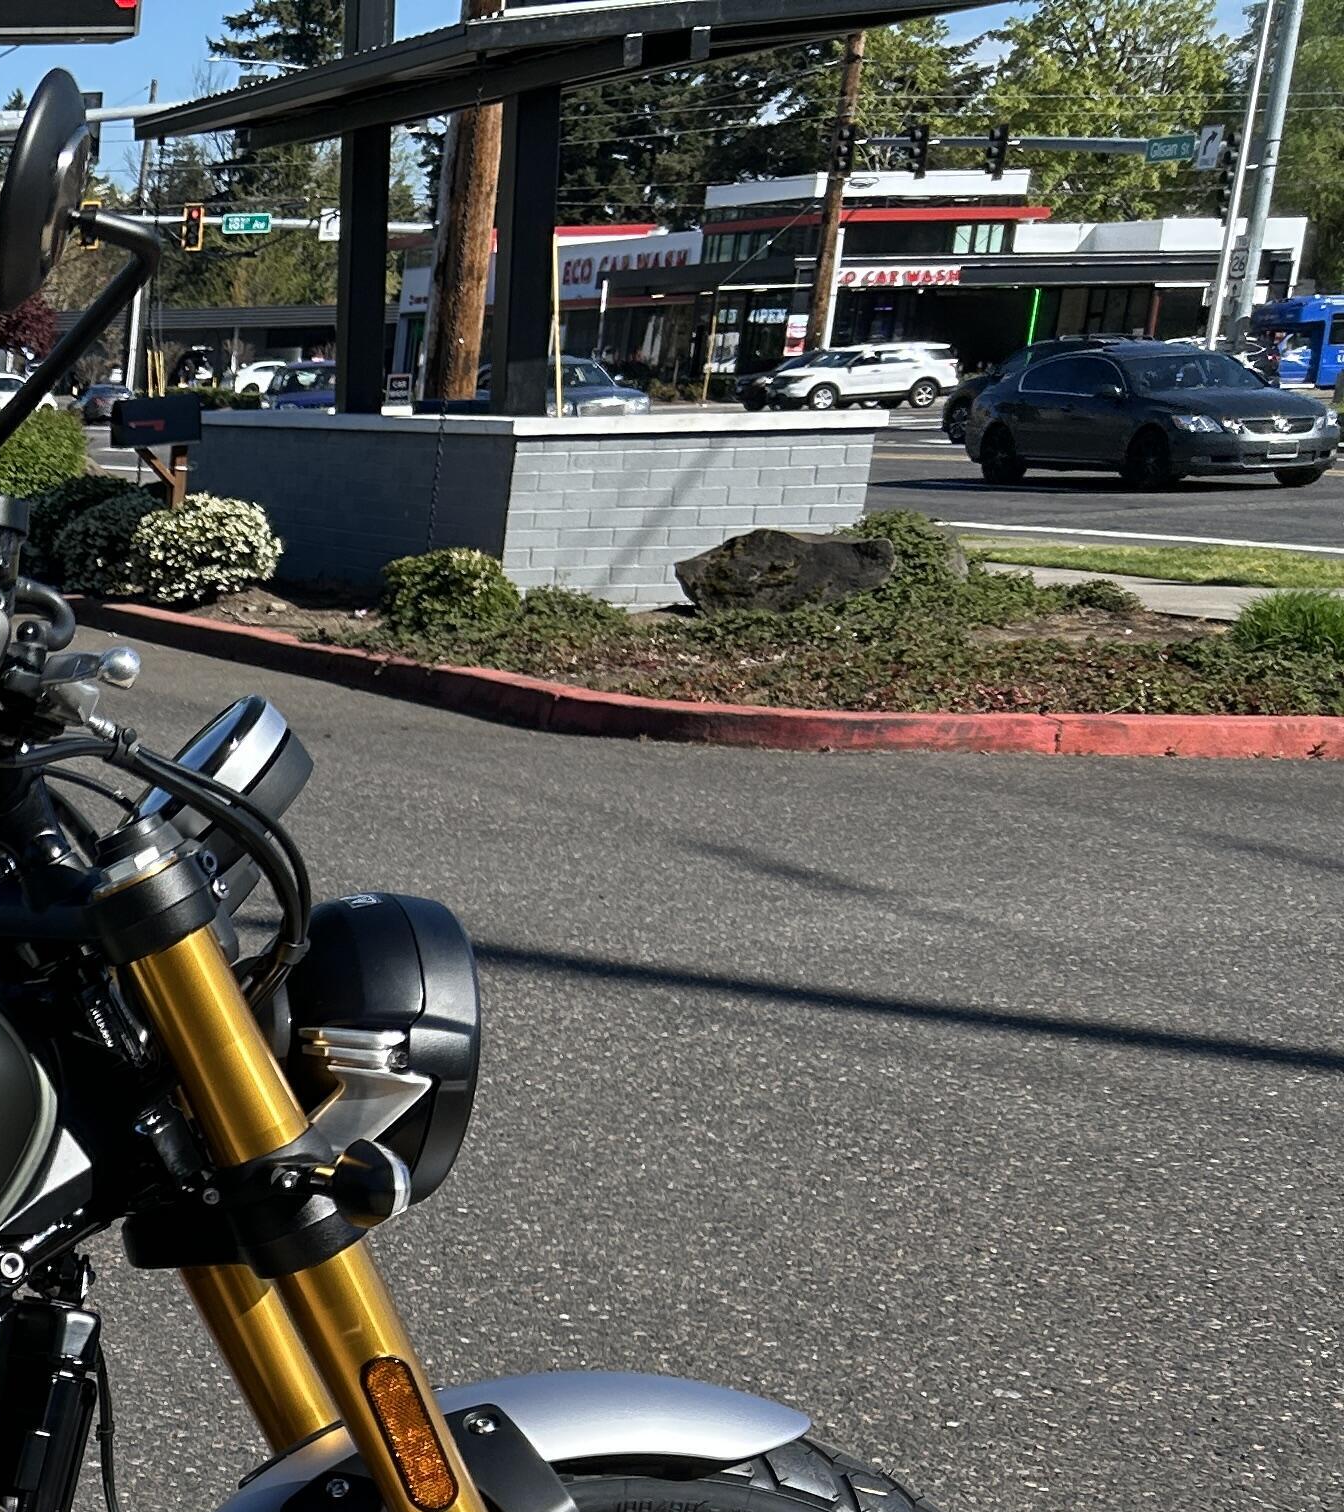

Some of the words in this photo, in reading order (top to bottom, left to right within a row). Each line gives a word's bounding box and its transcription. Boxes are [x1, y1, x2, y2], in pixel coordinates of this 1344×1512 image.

[1151, 143, 1178, 158] Glisan
[563, 257, 592, 285] ECO
[1231, 255, 1245, 272] 26
[861, 270, 899, 285] CAR
[903, 269, 961, 284] WASH
